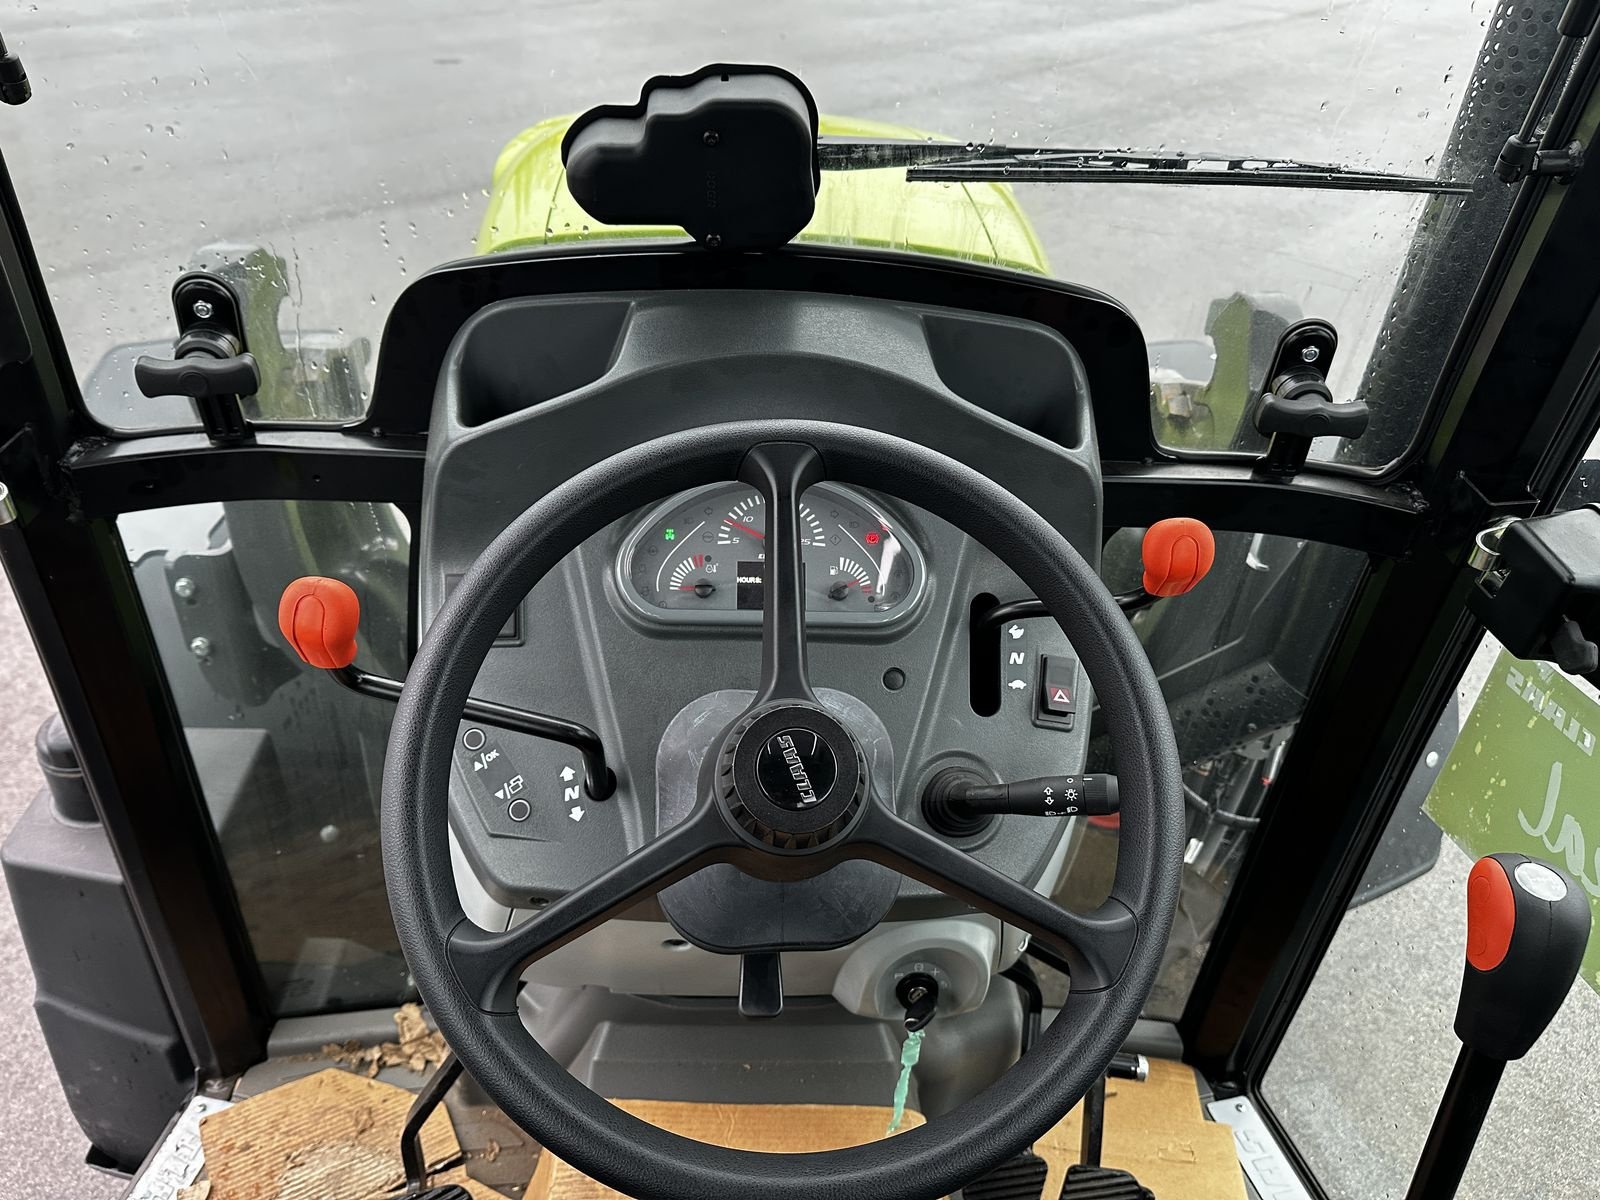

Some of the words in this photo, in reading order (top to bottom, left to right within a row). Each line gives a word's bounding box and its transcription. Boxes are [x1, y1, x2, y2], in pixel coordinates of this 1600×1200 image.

[1009, 652, 1025, 665] N
[777, 735, 817, 803] CLAAS
[564, 785, 580, 802] N
